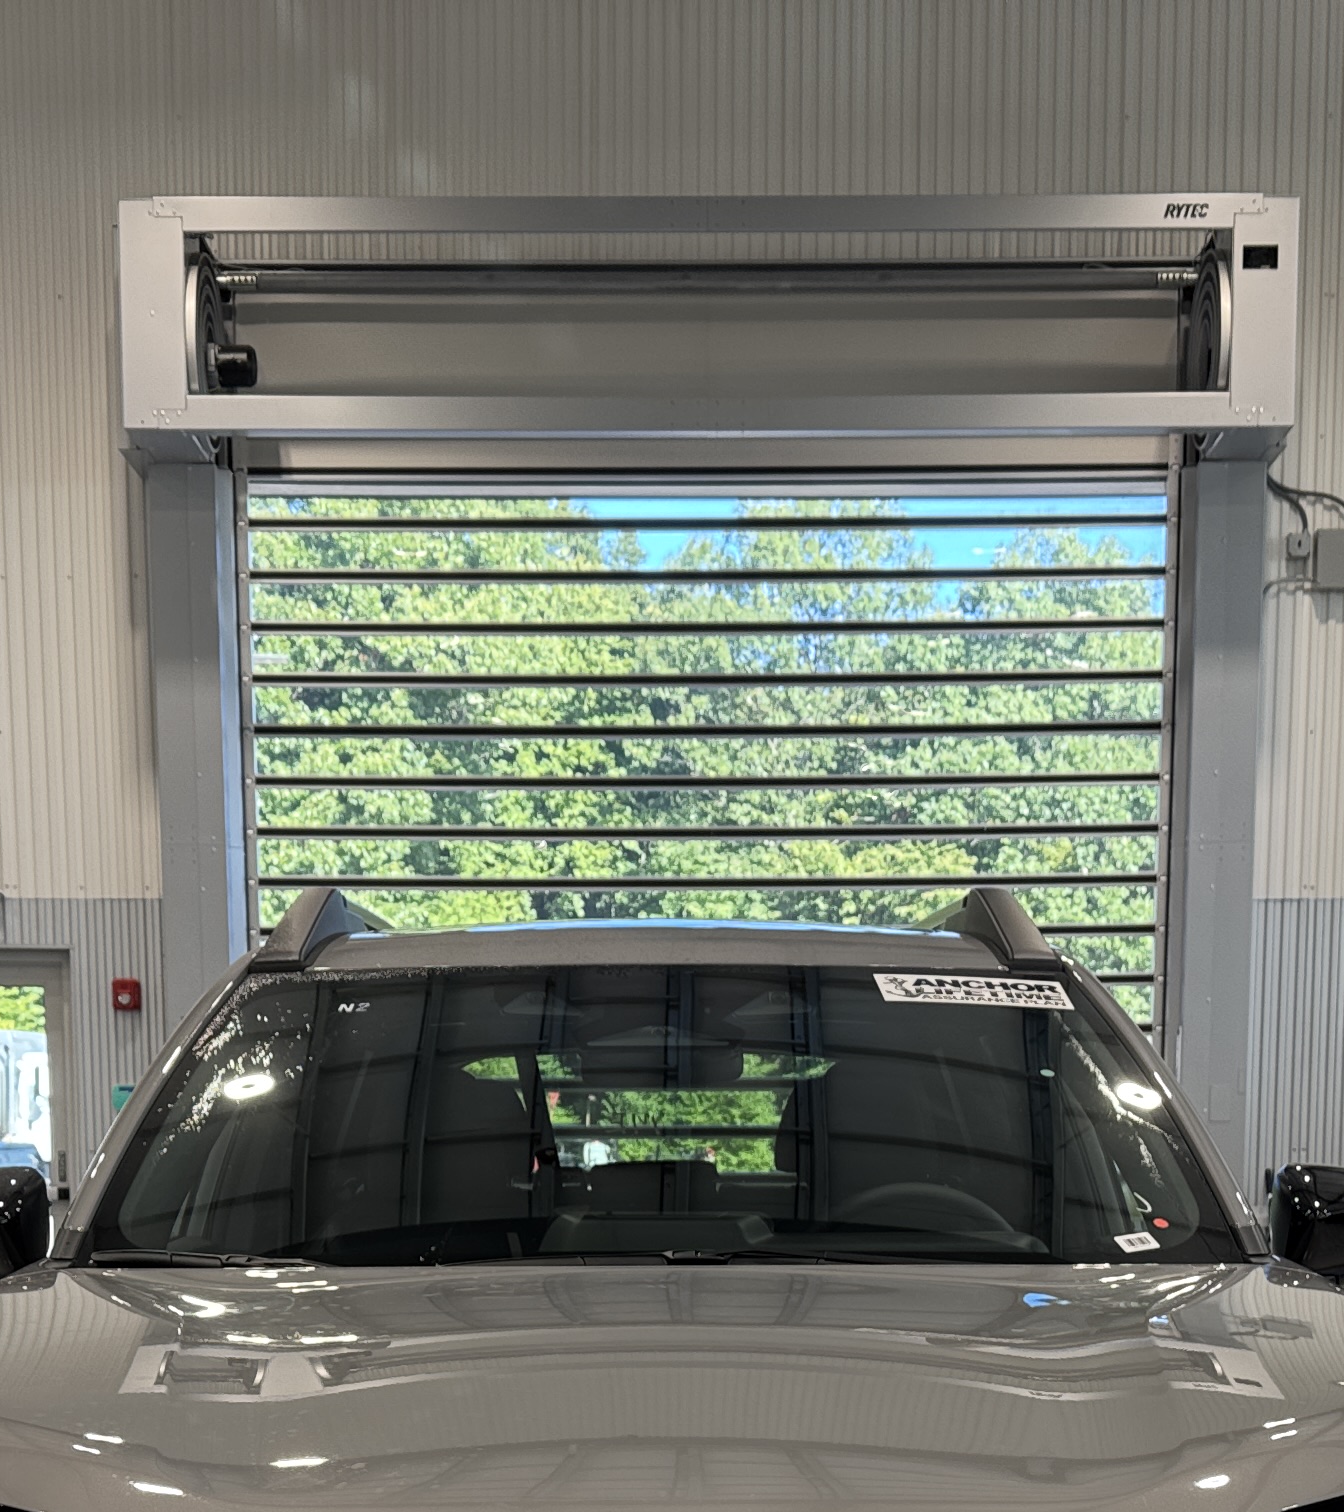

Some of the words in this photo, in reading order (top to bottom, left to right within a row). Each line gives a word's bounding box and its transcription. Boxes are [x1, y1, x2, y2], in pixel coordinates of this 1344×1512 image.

[1163, 202, 1209, 219] RYTEC
[912, 978, 1061, 995] ANCHOR
[916, 987, 1065, 1001] LIFETIME
[1024, 999, 1067, 1007] PLAN
